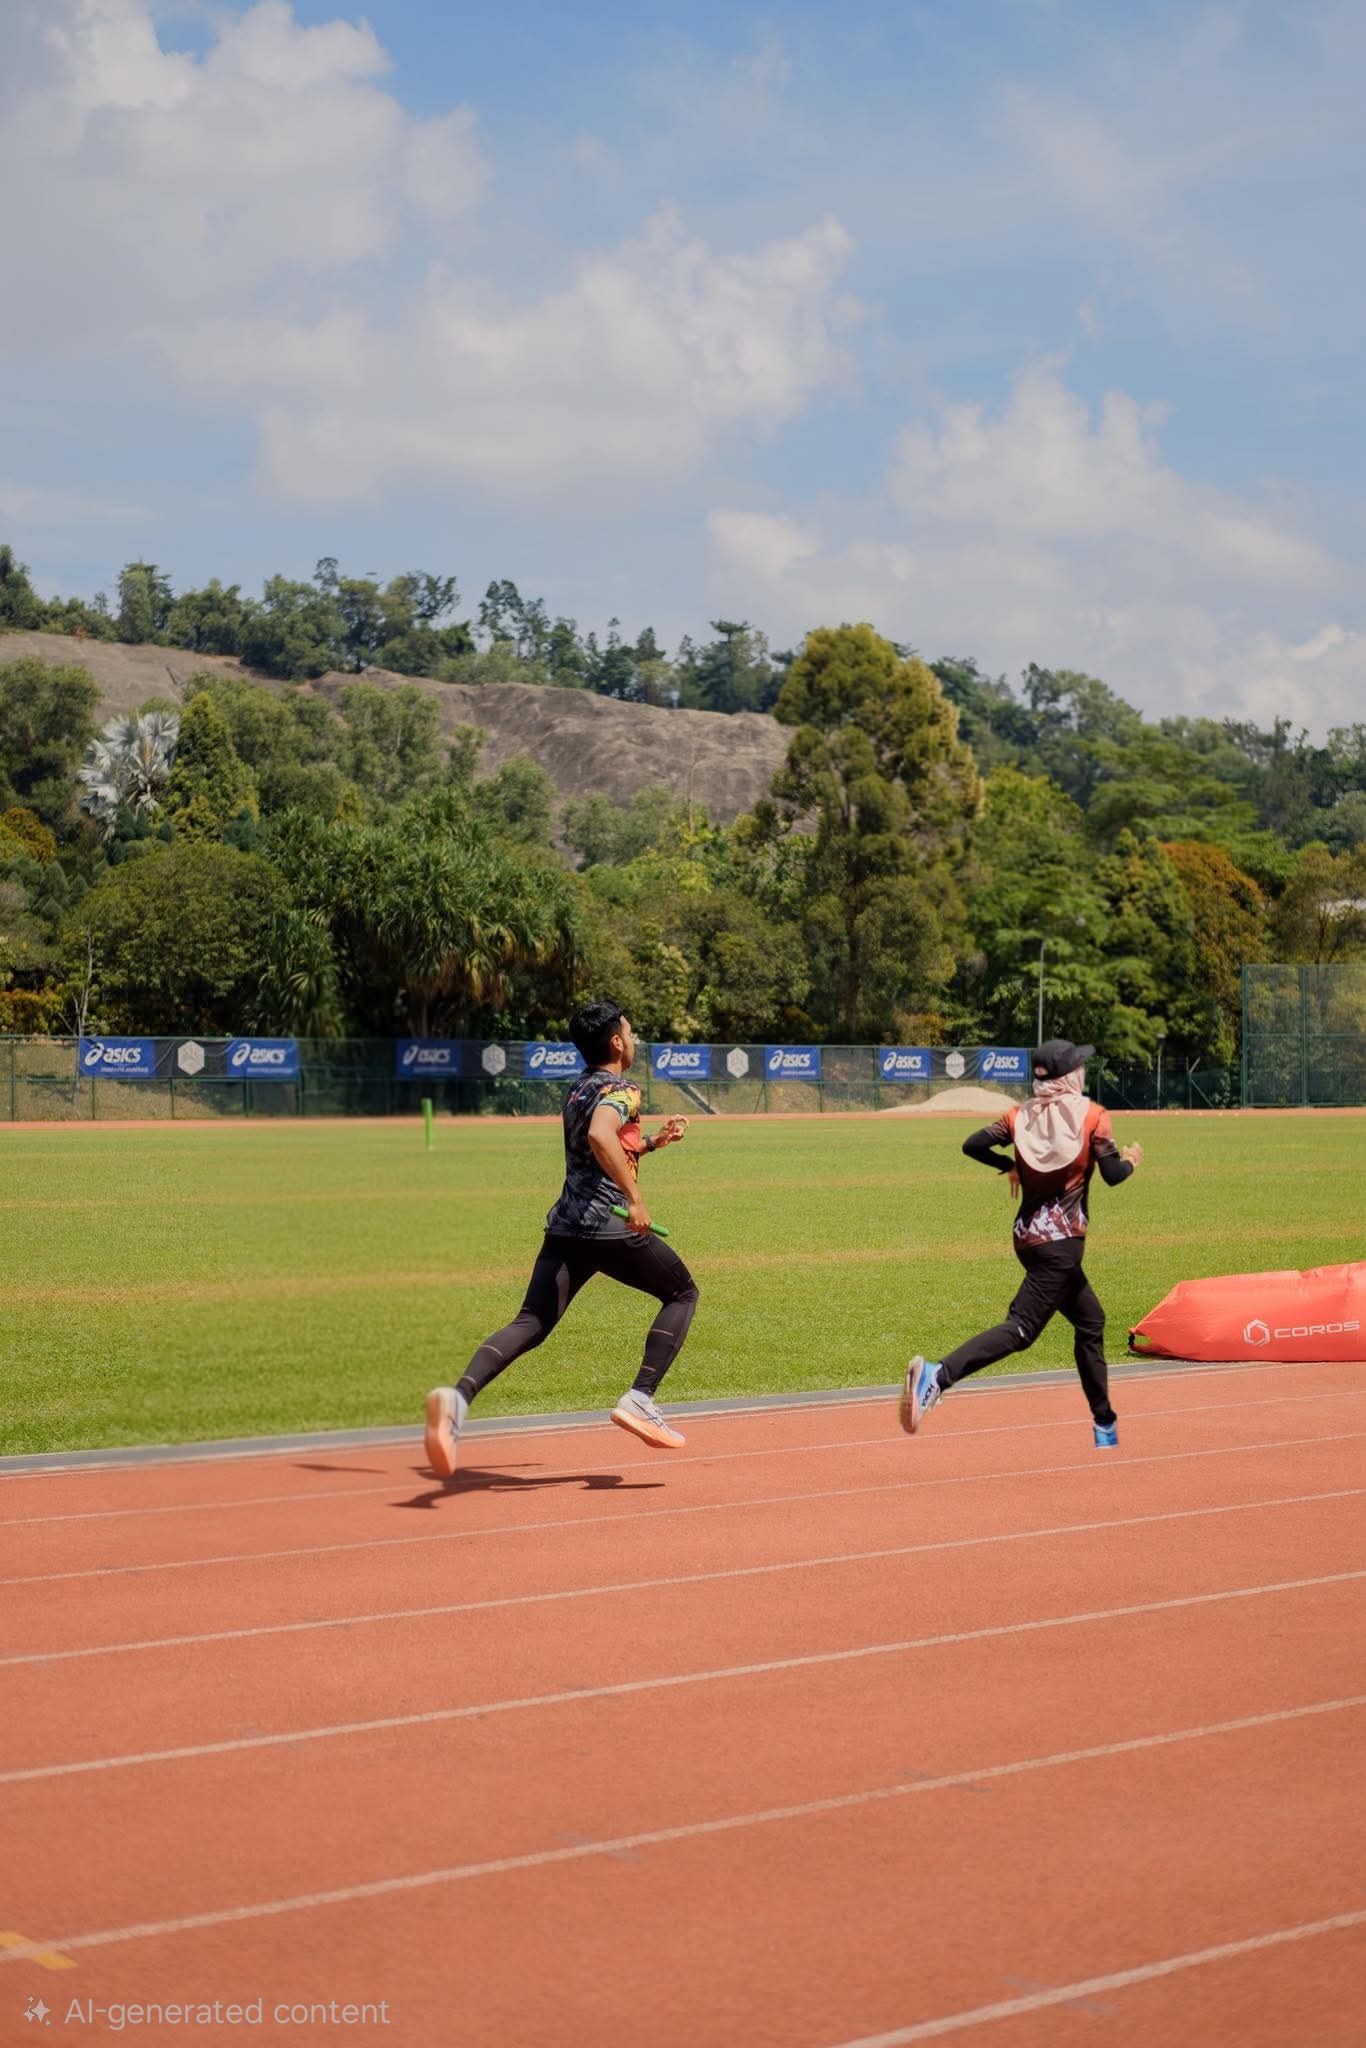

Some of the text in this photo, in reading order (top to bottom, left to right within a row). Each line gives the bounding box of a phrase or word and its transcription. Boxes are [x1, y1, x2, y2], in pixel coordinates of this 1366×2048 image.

[103, 1048, 141, 1063] asics
[994, 1056, 1019, 1069] asics
[1274, 1320, 1360, 1338] COROS
